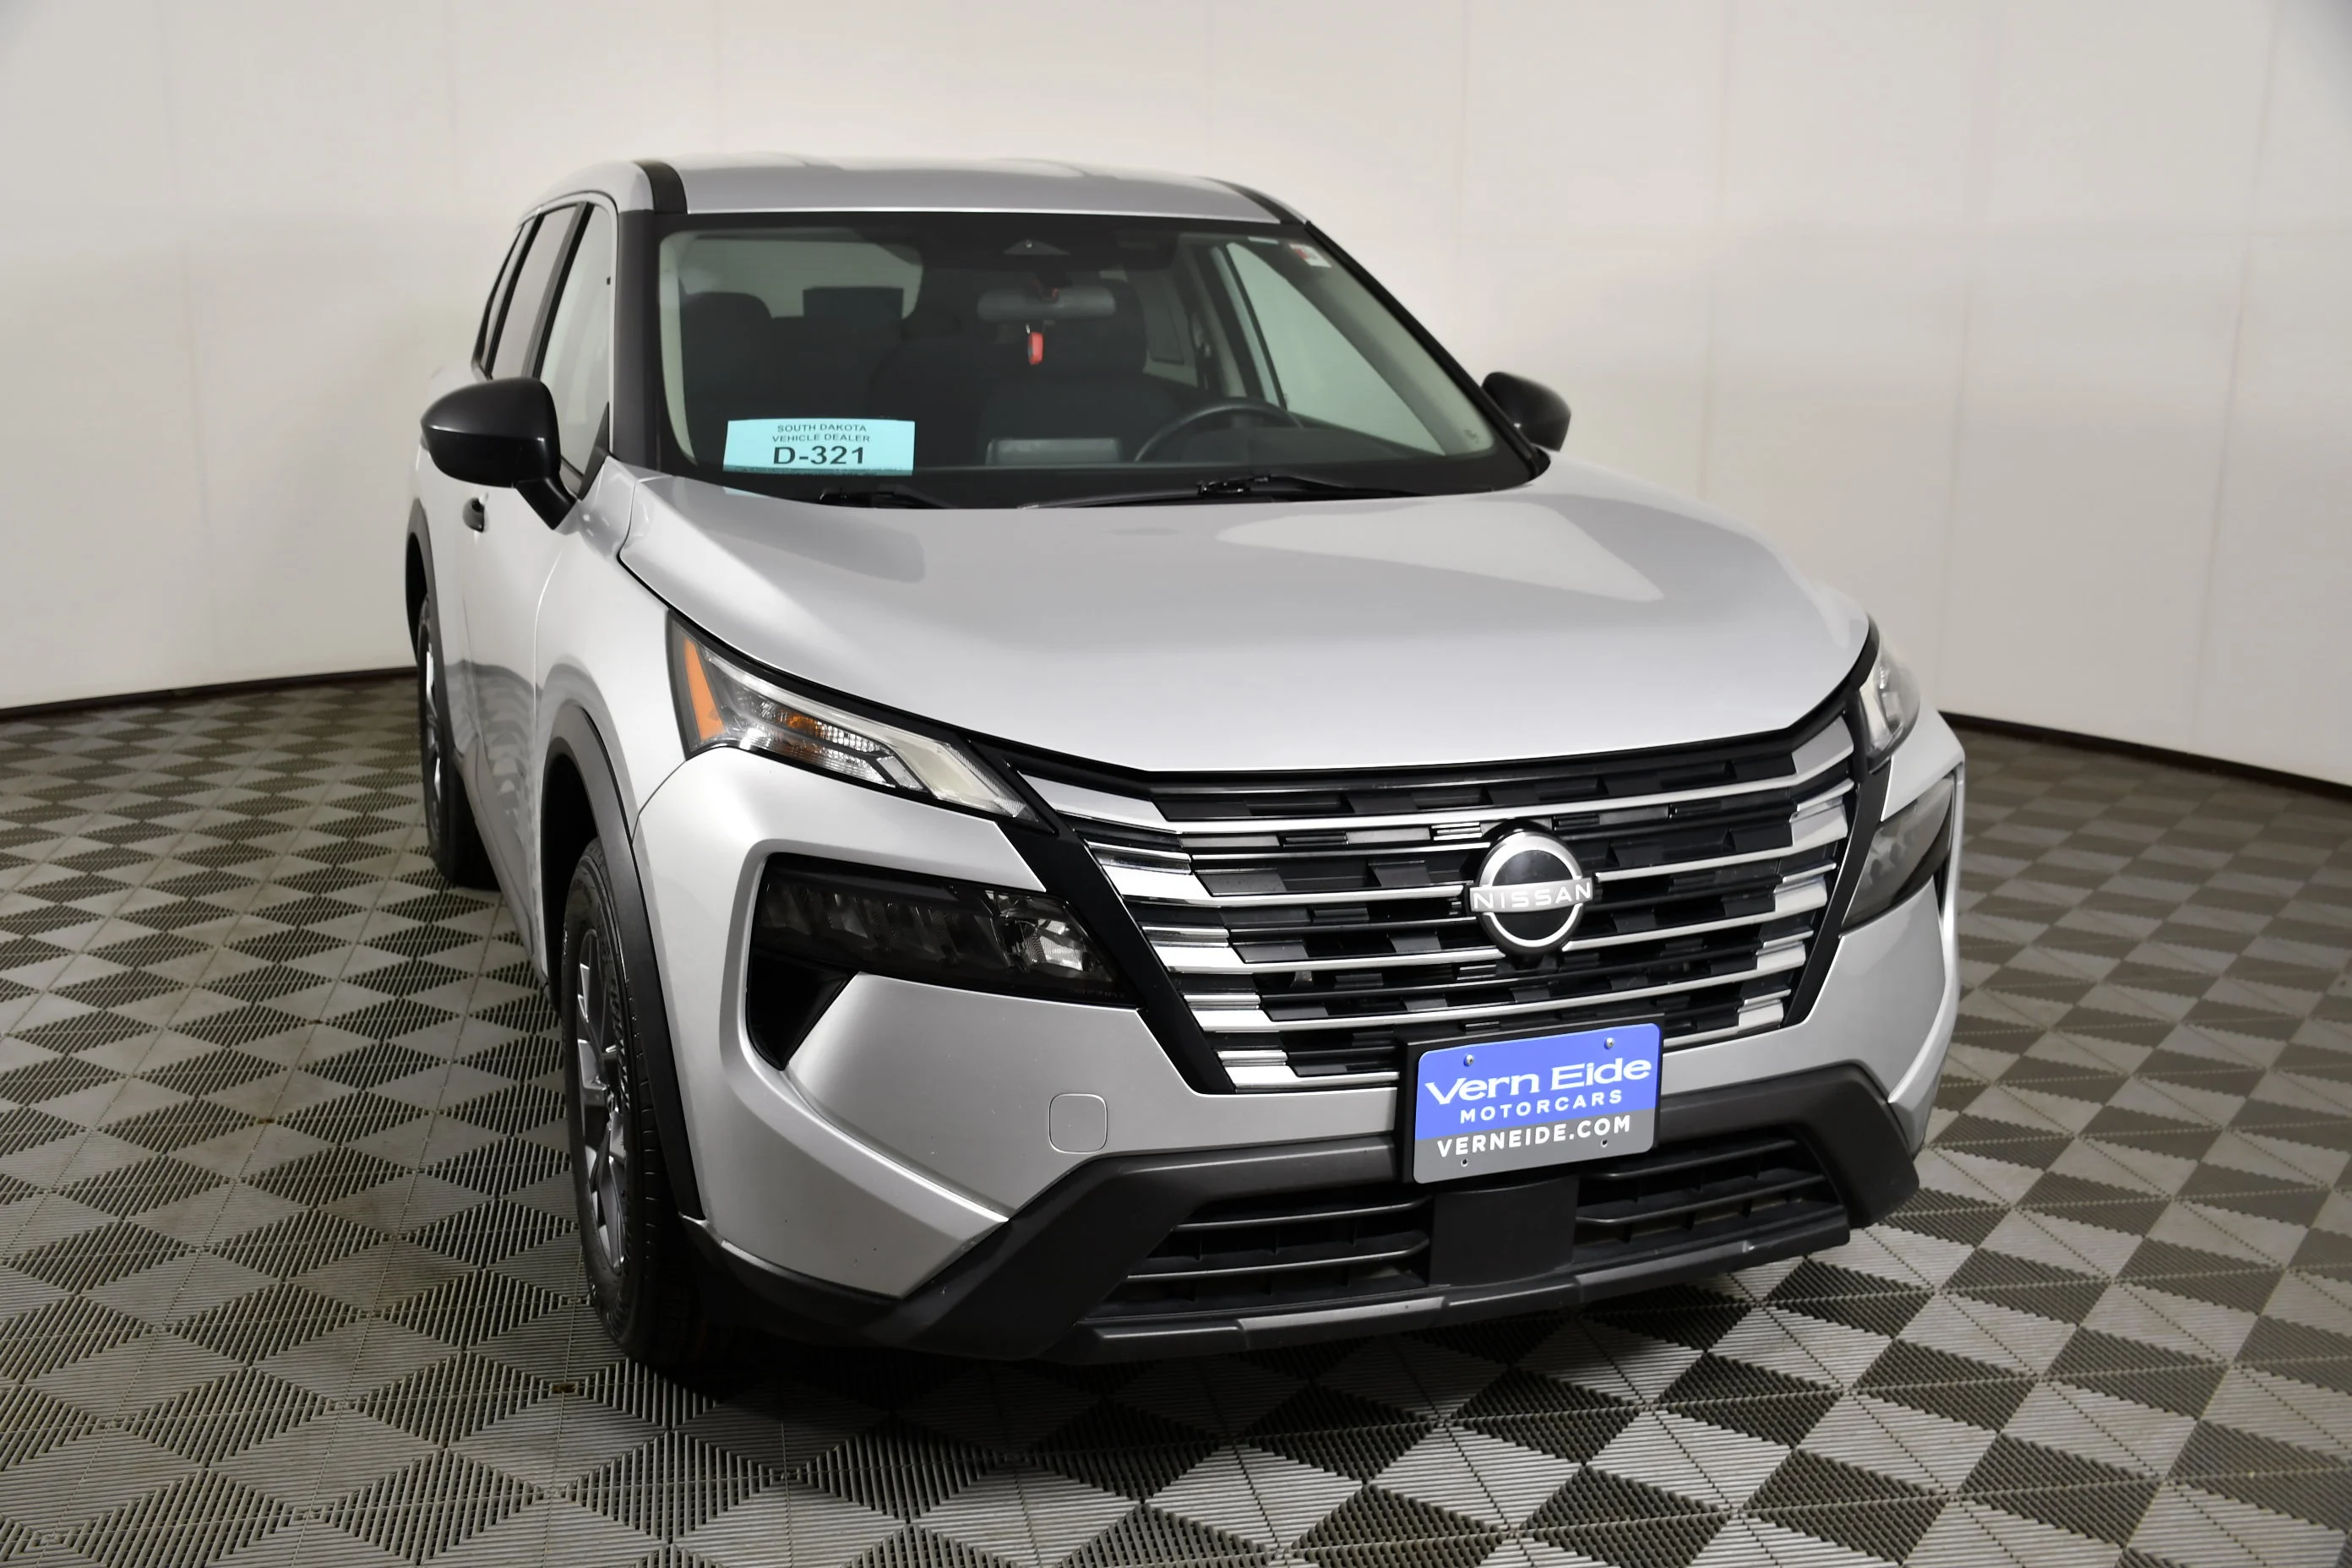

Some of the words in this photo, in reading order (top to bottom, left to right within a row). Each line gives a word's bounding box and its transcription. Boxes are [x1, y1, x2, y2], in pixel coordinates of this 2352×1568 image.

[772, 433, 819, 442] VEHICLE
[824, 433, 870, 443] DEALER
[777, 424, 816, 433] SOUTH
[819, 423, 867, 432] DAKOTA
[773, 445, 863, 465] D-321
[1473, 881, 1592, 910] NISSAN
[1424, 1073, 1540, 1105] Vern
[1550, 1058, 1652, 1091] Eide
[1460, 1089, 1622, 1124] MOTORCARS
[1437, 1115, 1631, 1157] VERNEIDE.COM
